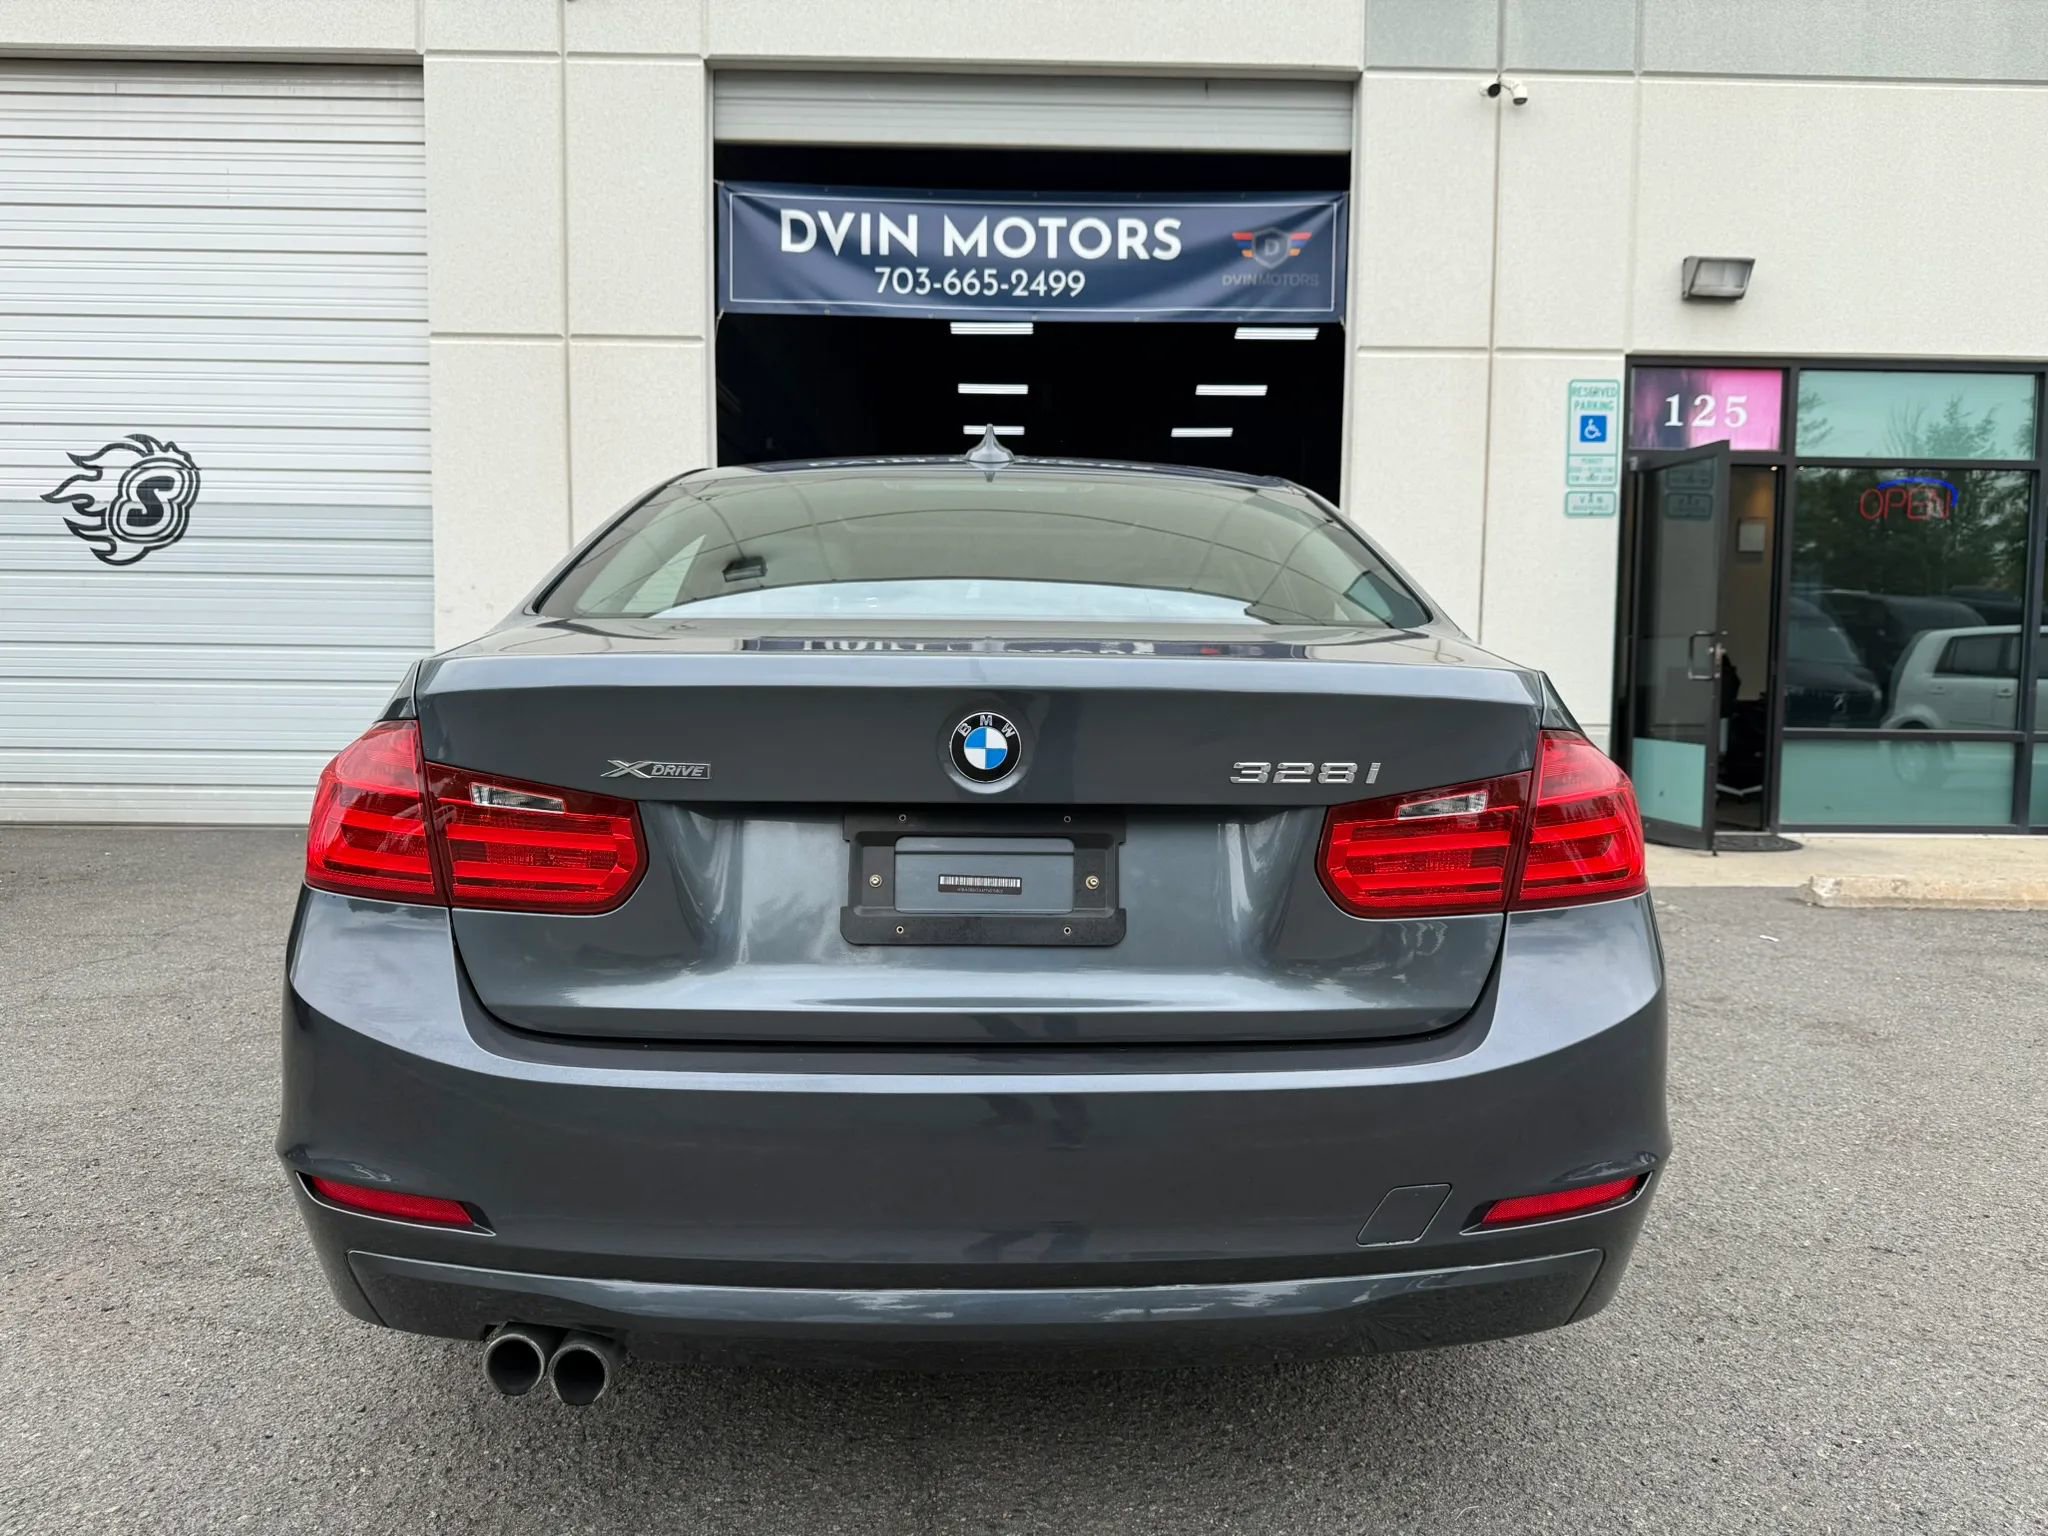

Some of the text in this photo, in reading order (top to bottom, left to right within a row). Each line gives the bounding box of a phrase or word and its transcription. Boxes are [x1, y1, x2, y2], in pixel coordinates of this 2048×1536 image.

[779, 208, 1182, 262] DVIN MOTORS
[875, 266, 1087, 298] 703-665-2499
[1571, 386, 1617, 398] RESERVED
[1574, 400, 1615, 411] PARKING
[1664, 393, 1749, 428] 125
[1859, 487, 1952, 520] OPEN
[957, 714, 1016, 738] BMW
